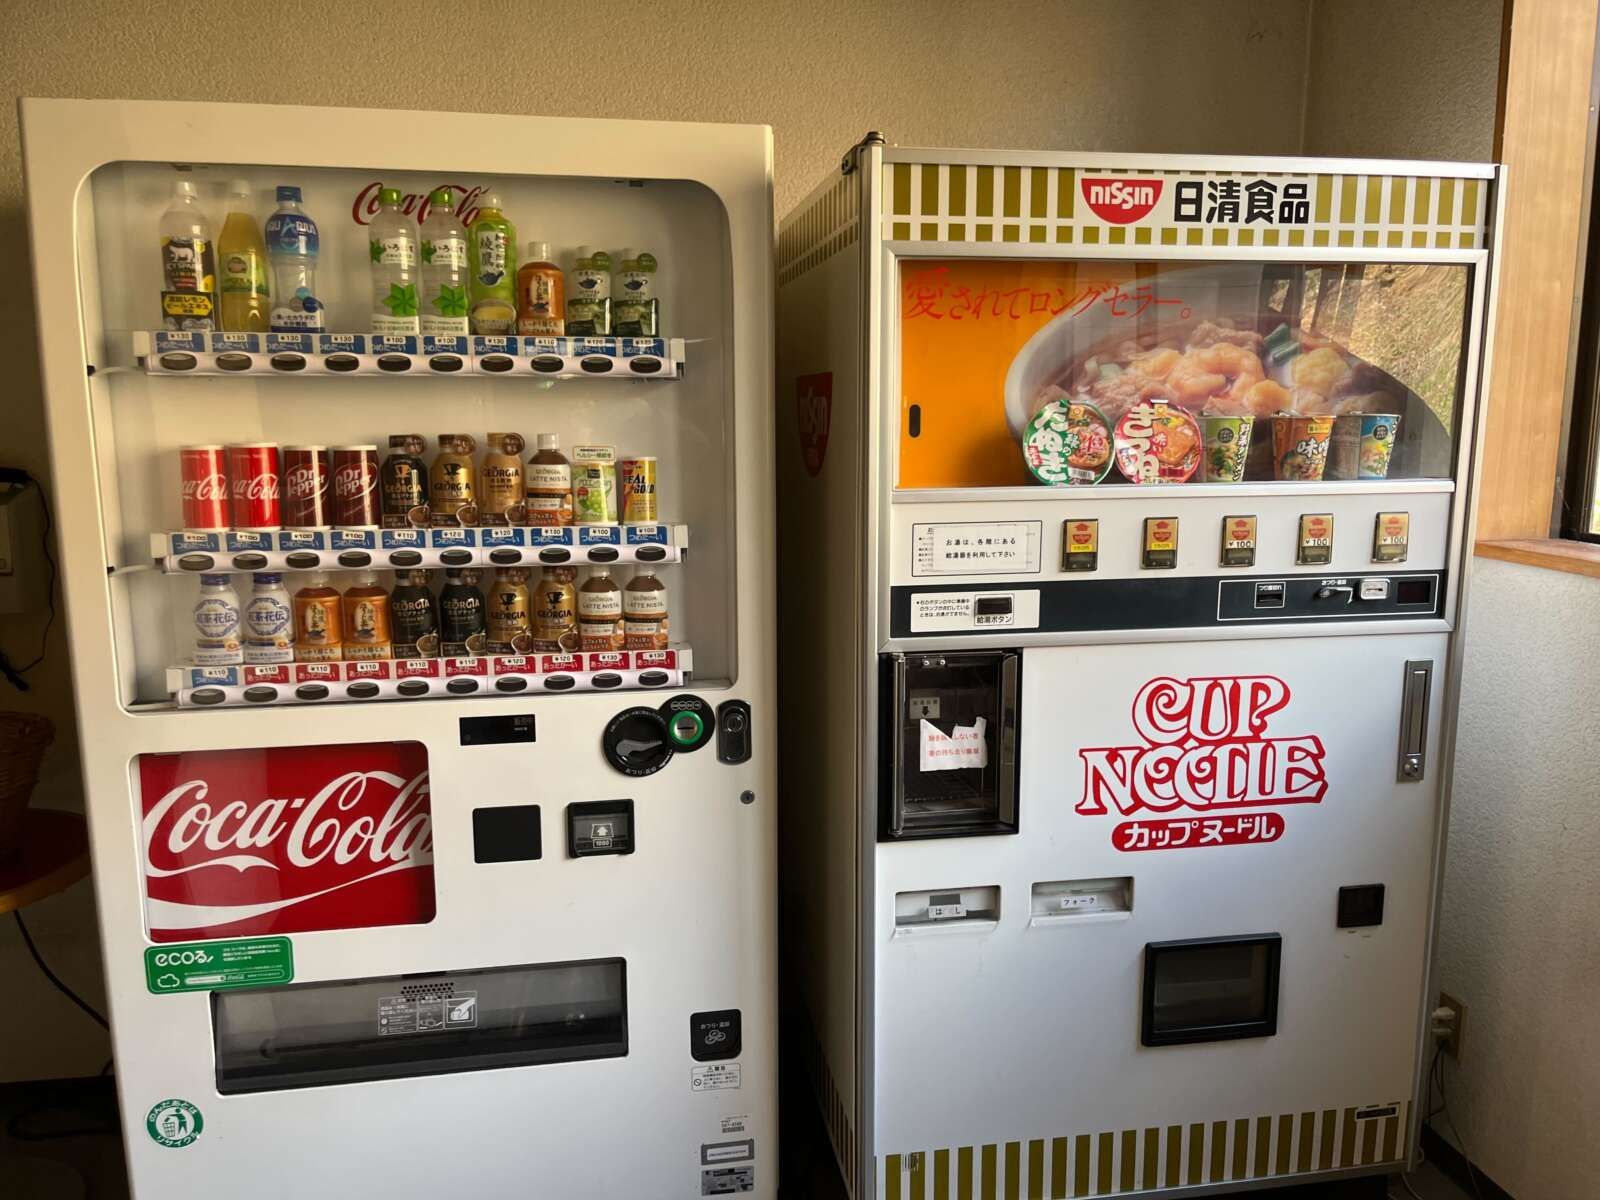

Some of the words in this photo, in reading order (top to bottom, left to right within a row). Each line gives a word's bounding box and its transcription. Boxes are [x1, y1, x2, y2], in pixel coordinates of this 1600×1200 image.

[1174, 179, 1310, 224] 日清食品
[906, 266, 1192, 320] 愛されてロングセラー。
[297, 469, 315, 480] Dr
[343, 469, 361, 480] Dr
[977, 616, 1012, 625] 給湯ボタン
[1132, 675, 1290, 744] CUP
[1075, 735, 1328, 816] NOODLE
[142, 771, 433, 877] Coca-Cola
[1123, 816, 1276, 849] カップヌードル
[149, 1101, 198, 1122] のんだあとは
[157, 1131, 200, 1147] リサイクル
